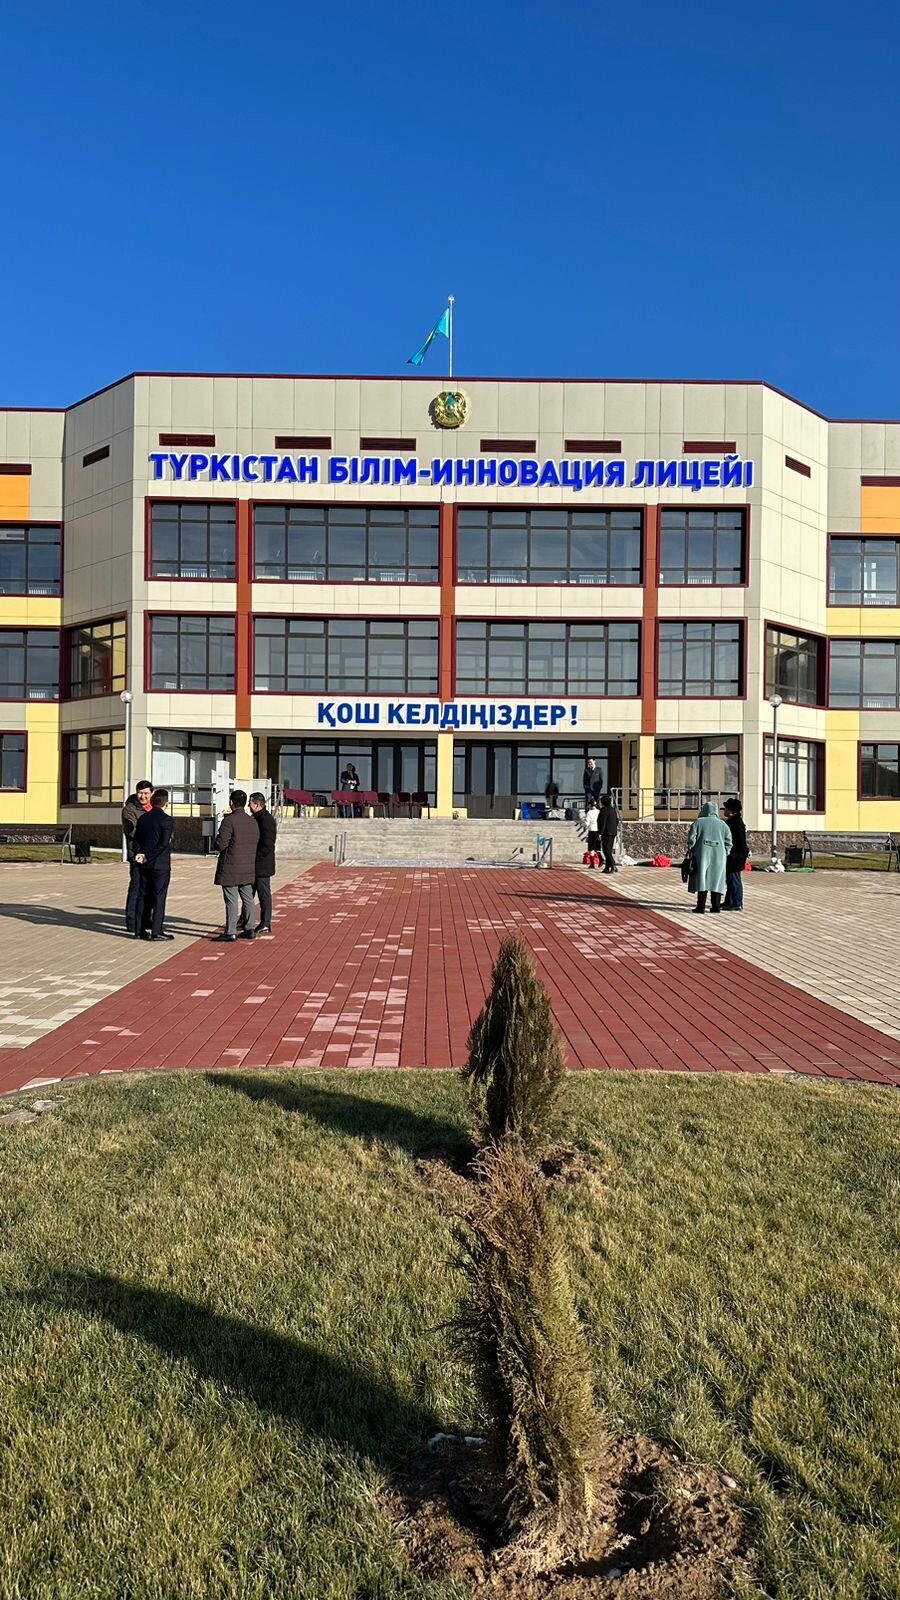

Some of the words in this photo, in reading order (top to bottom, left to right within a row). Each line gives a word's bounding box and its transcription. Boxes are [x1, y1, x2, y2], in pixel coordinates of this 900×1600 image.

[149, 453, 318, 483] ТҮРКІСТАН
[330, 457, 624, 491] БІЛІМ-ИННОВАЦИЯ
[632, 454, 754, 492] ЛИЦЕЙІ
[318, 702, 379, 727] ҚОШ
[388, 703, 578, 729] КЕЛДІҢІЗДЕР!
